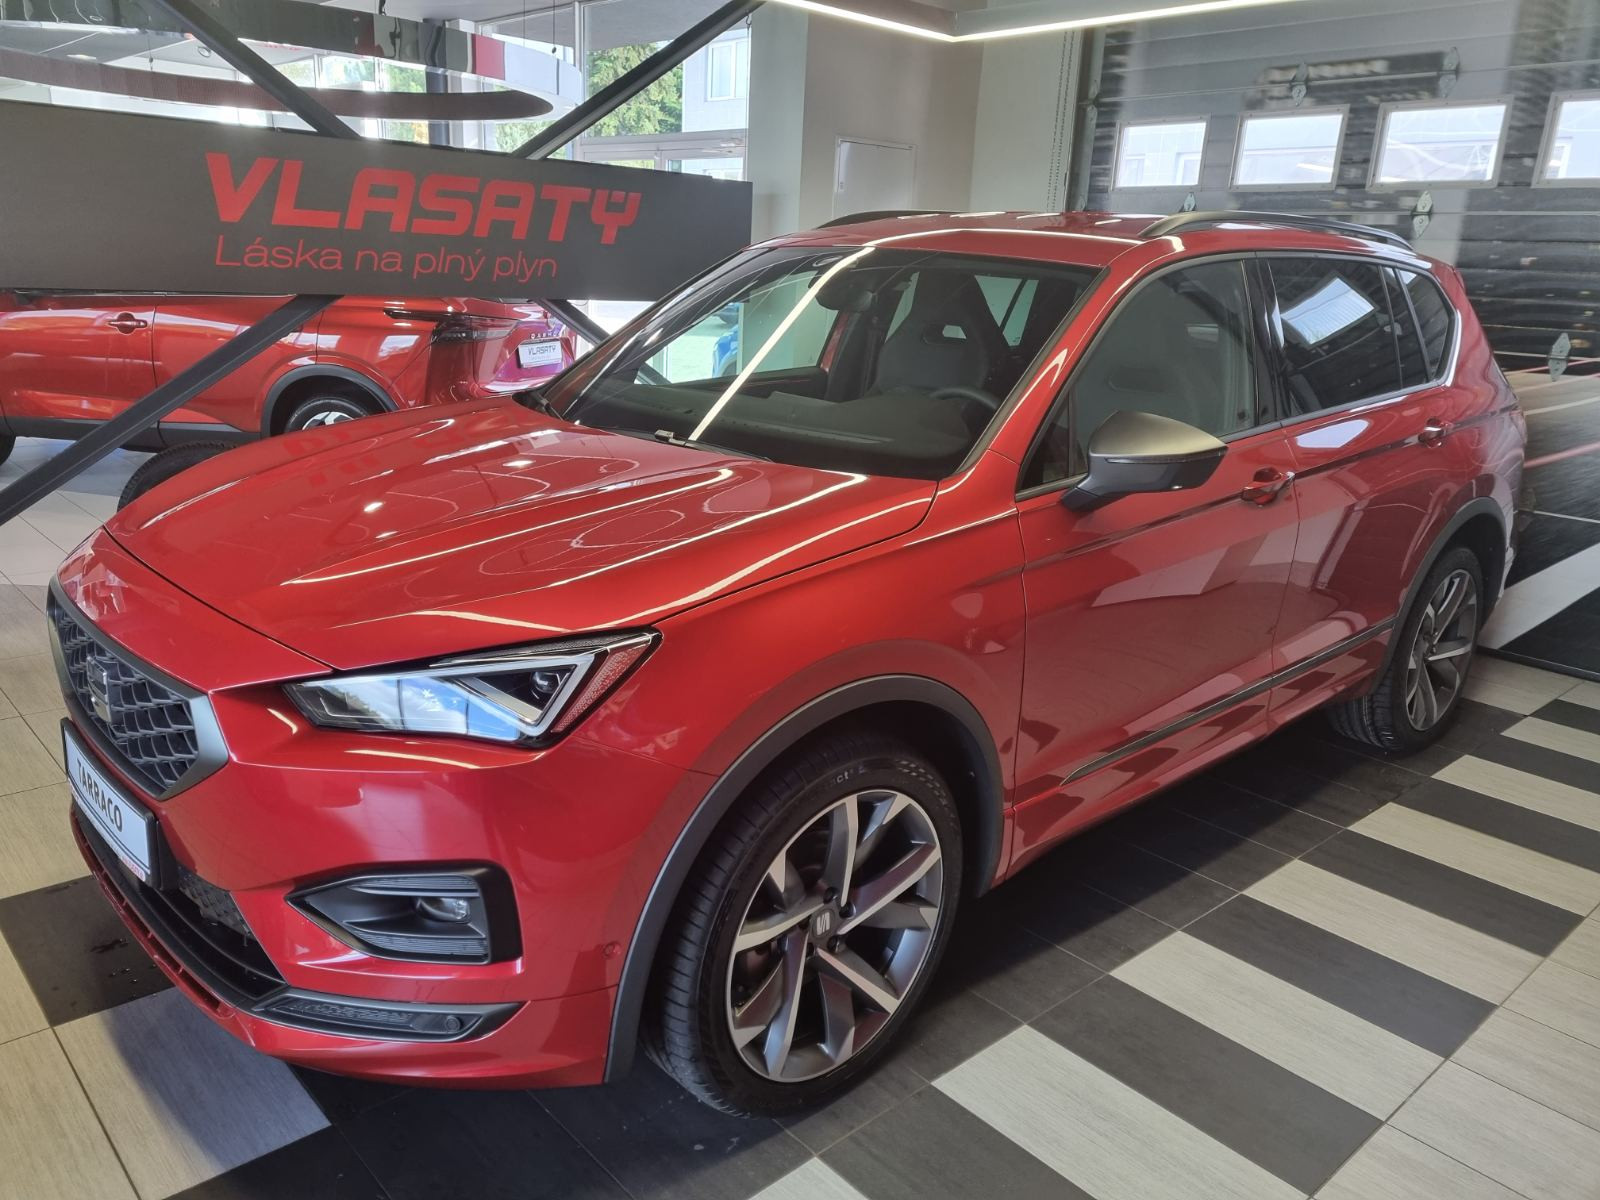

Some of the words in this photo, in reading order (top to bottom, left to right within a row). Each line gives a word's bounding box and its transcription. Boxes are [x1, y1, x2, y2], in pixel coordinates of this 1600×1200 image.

[215, 234, 343, 271] Láska
[355, 249, 403, 273] na
[412, 246, 486, 282] plný
[492, 250, 559, 284] plyn
[76, 757, 123, 832] TARRACO
